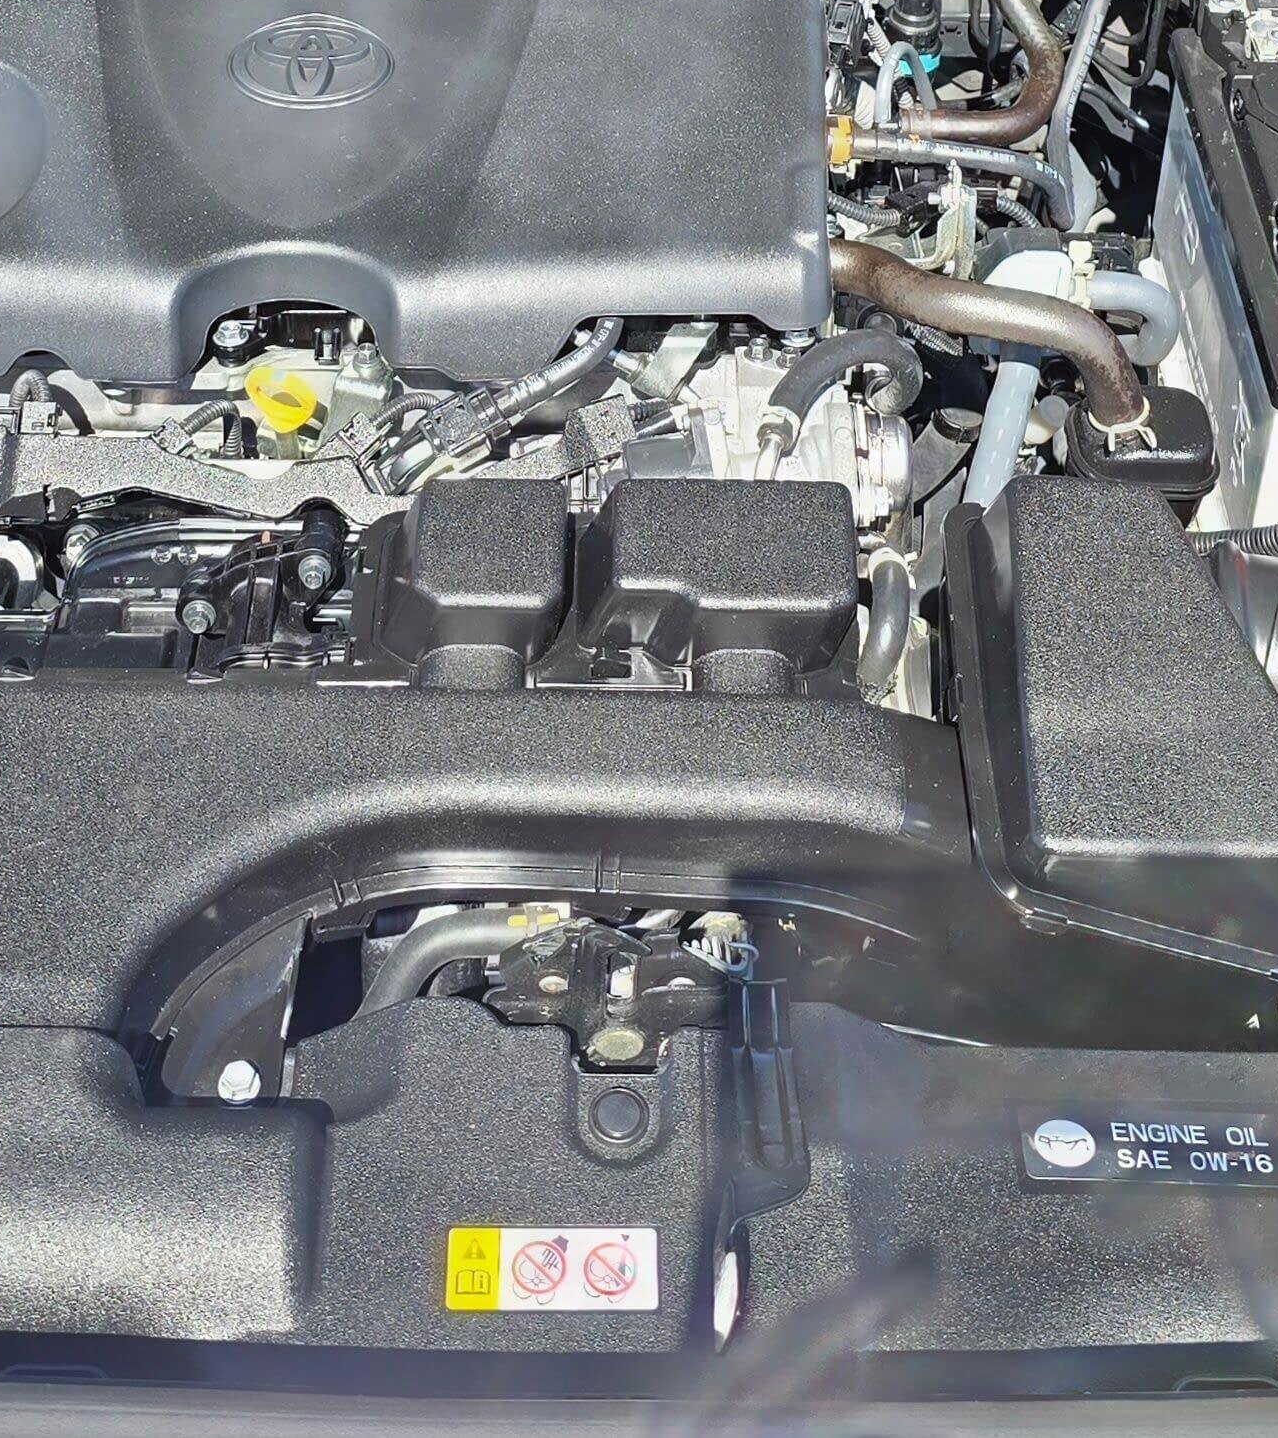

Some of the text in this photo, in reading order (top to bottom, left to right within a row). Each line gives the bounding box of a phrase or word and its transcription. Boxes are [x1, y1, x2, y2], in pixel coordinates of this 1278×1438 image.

[1110, 1121, 1270, 1147] ENGINE OIL
[1116, 1148, 1173, 1171] SAE
